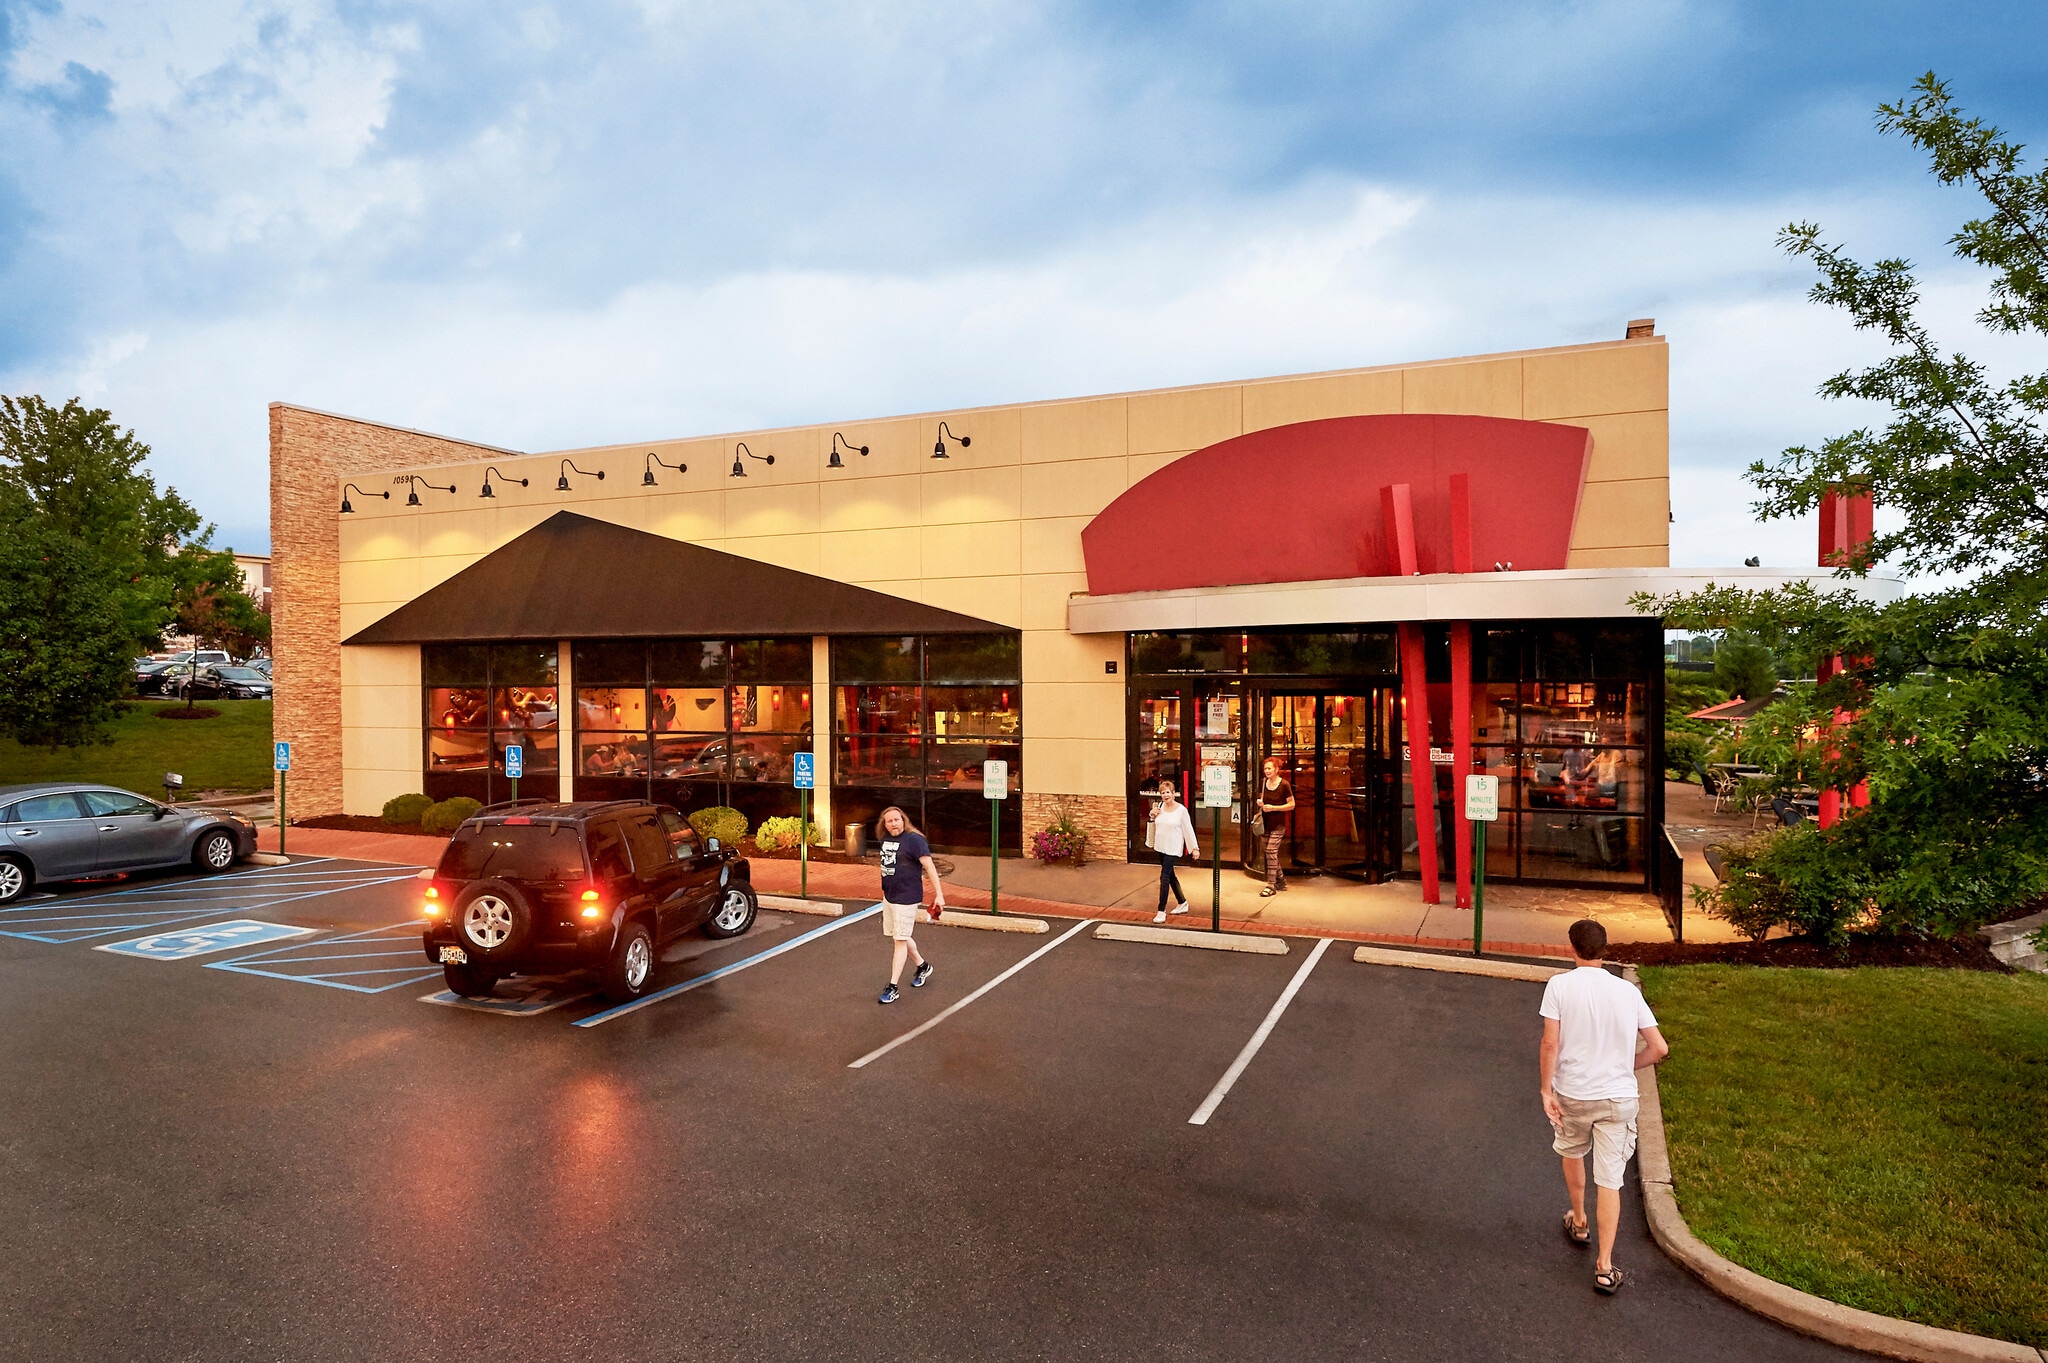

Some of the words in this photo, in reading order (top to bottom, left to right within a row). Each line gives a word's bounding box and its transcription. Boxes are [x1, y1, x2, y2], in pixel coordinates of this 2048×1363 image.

[991, 765, 1000, 774] 15
[1213, 770, 1222, 780] 15
[1477, 780, 1488, 791] 15
[1206, 794, 1229, 802] PARKING
[1470, 796, 1493, 804] MINUTE
[1468, 806, 1495, 815] PARKING
[1232, 812, 1240, 820] A
